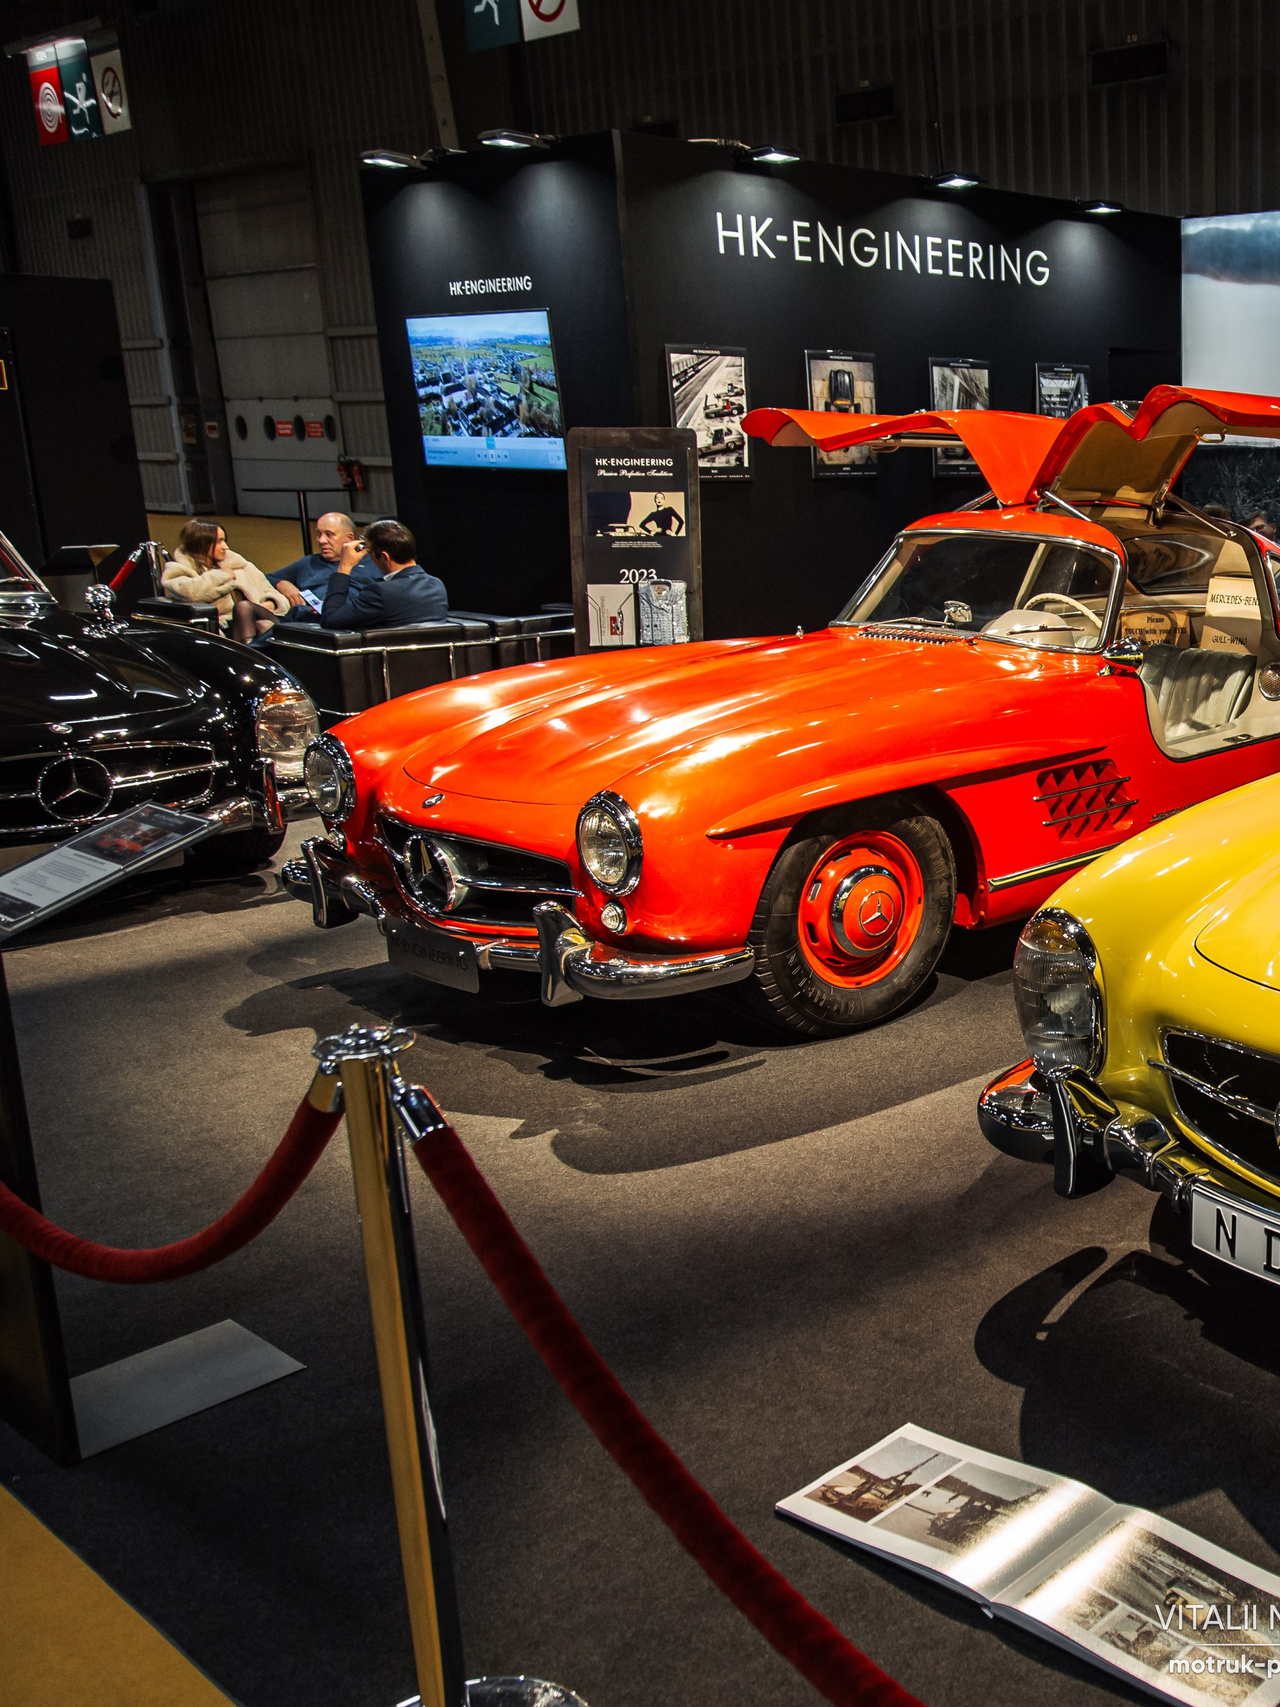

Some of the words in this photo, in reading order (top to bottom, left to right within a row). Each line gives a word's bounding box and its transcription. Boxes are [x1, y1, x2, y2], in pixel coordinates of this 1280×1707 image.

[716, 212, 1050, 286] HK-ENGINEERING
[449, 275, 533, 296] HK-ENGINEERING
[595, 458, 674, 467] HK-ENGINEERING
[619, 568, 658, 584] 2023
[1209, 594, 1259, 606] MERCEDES-BEN
[1215, 1206, 1238, 1259] N
